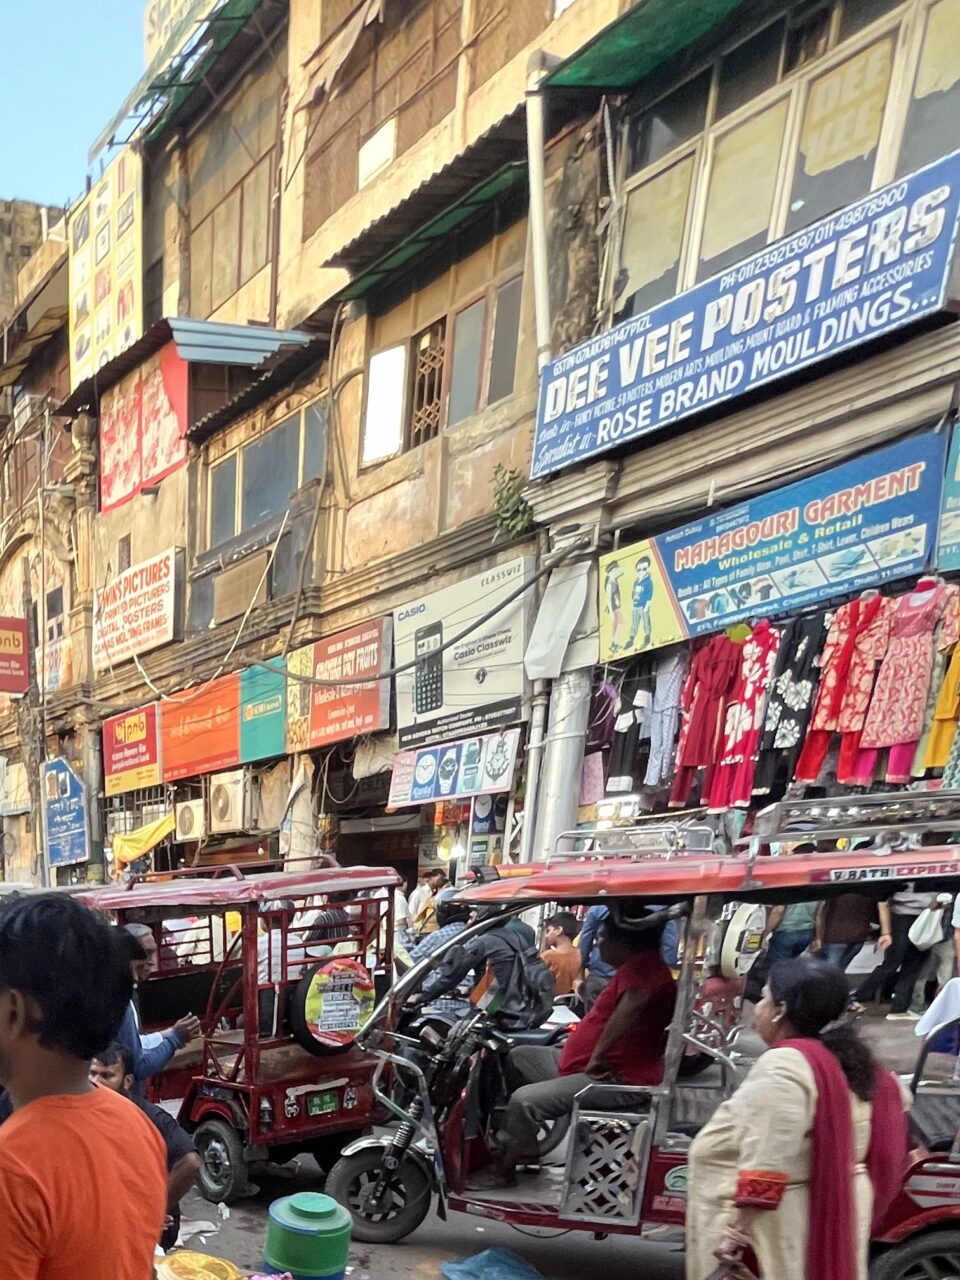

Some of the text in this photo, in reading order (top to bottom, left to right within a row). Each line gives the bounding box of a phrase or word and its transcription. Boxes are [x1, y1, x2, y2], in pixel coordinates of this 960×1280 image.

[543, 185, 951, 424] DEE VEE POSTERS
[775, 313, 803, 339] BOARD
[813, 285, 859, 320] FRAMING
[860, 251, 934, 299] ACCESSORIES
[597, 398, 652, 446] ROSE
[658, 359, 744, 420] BRAND
[675, 506, 799, 572] MAHAGOURI
[803, 461, 926, 525] GARMENT
[719, 514, 863, 570] Wholesale & Retail
[123, 554, 171, 598] PICTURES
[481, 563, 522, 587] CLASSWIZ
[123, 599, 164, 626] POSTERS
[398, 603, 426, 621] CASIO
[454, 647, 475, 661] Casio
[477, 634, 513, 653] Classwiz
[126, 715, 145, 740] pnb
